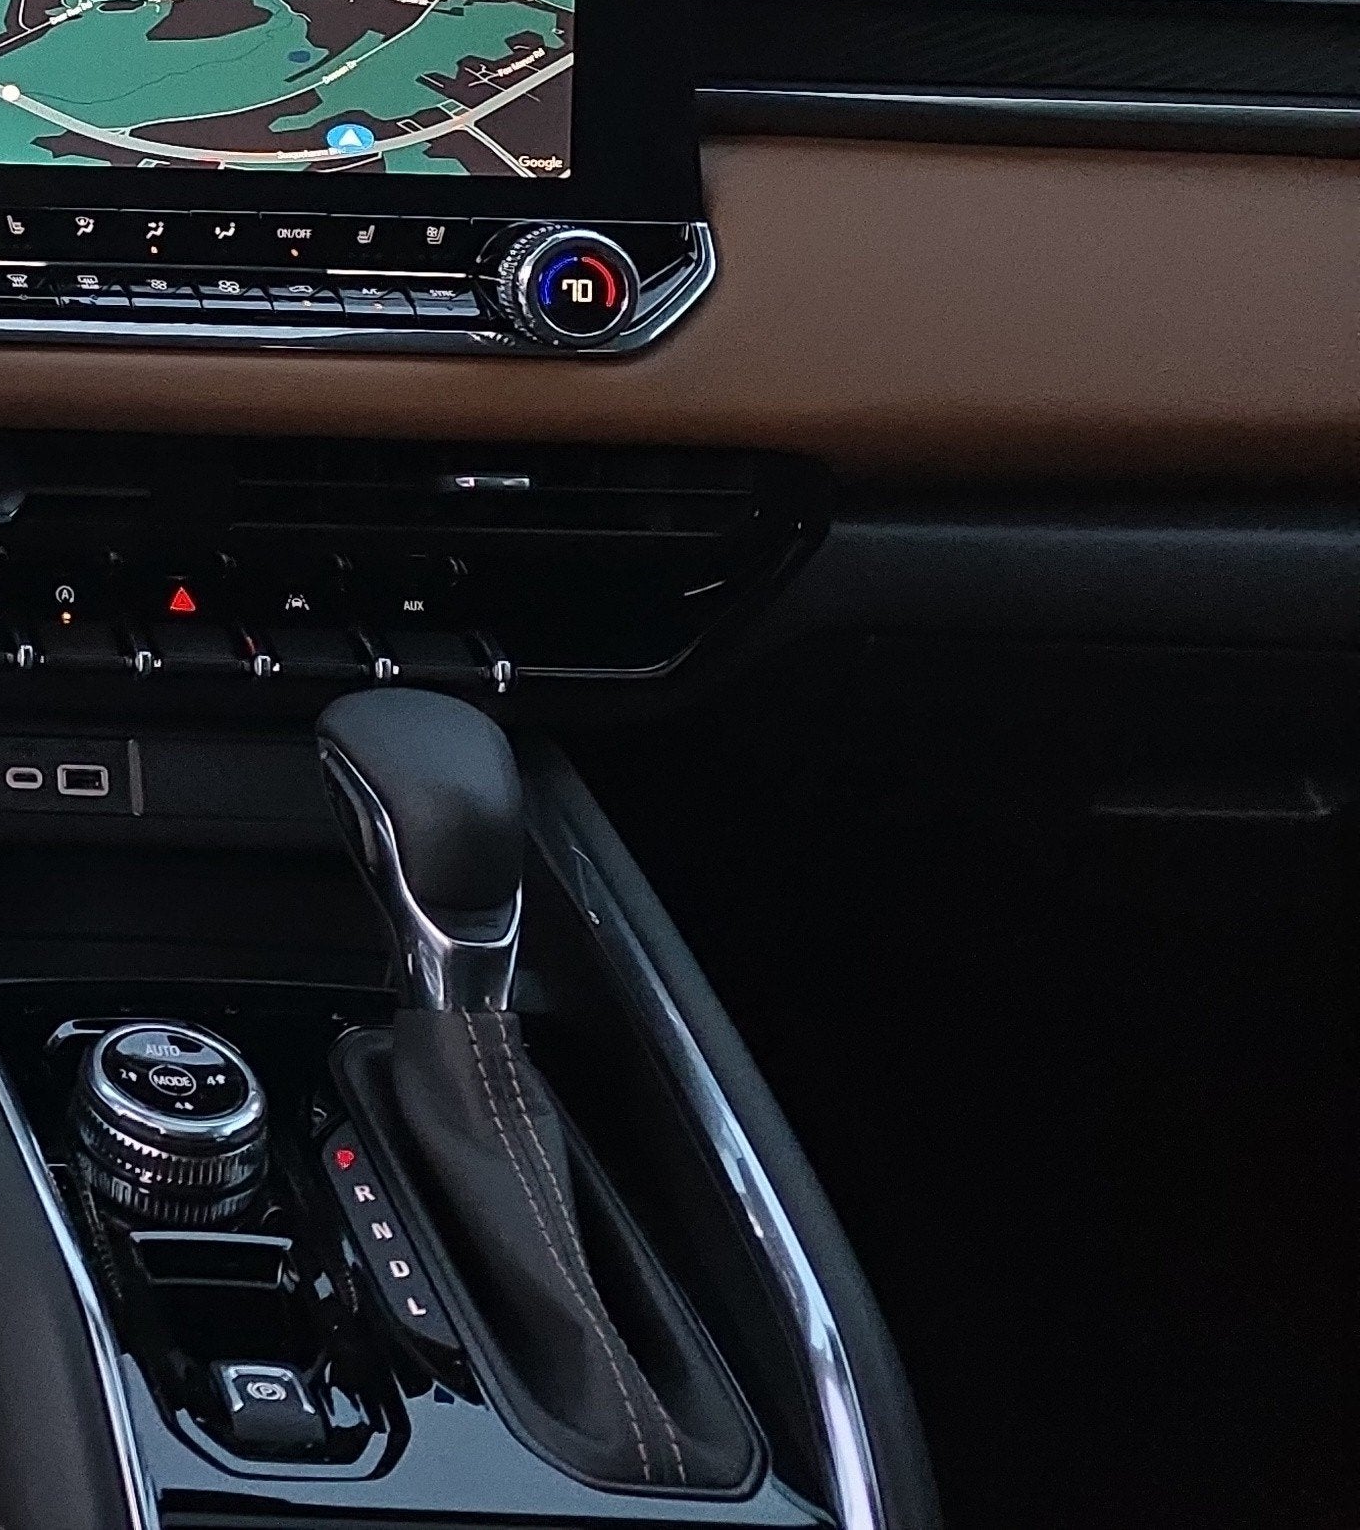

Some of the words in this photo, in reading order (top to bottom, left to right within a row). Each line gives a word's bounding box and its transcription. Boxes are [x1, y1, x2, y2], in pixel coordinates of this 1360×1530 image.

[518, 155, 564, 172] Google
[276, 227, 312, 239] ON/OFF
[561, 278, 593, 303] 70
[403, 600, 425, 612] AUX
[145, 1044, 181, 1057] AUTO
[152, 1074, 192, 1088] MODE
[353, 1184, 376, 1203] R
[371, 1221, 393, 1240] N
[389, 1260, 411, 1278] D
[406, 1297, 427, 1316] L
